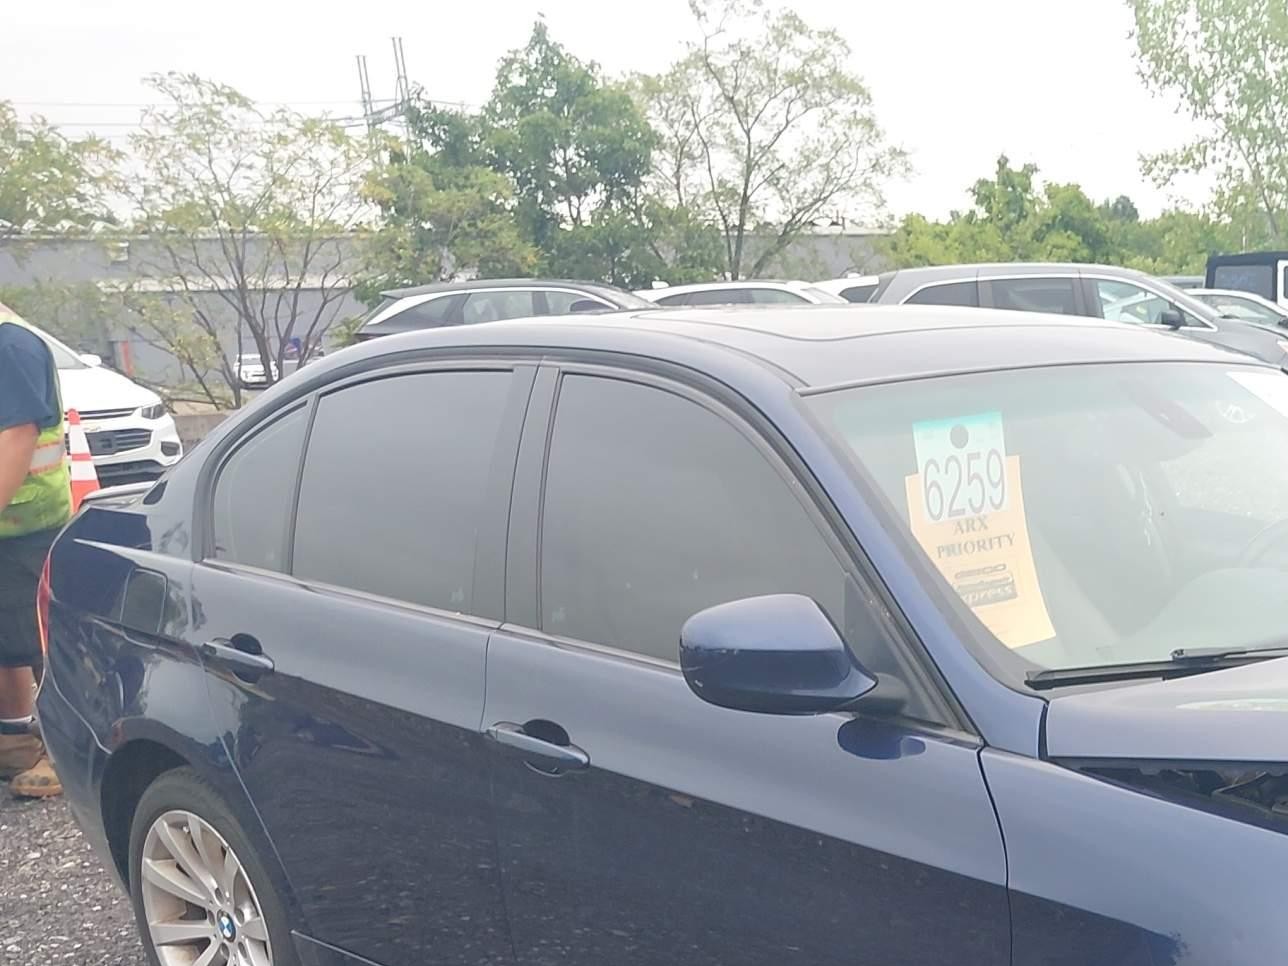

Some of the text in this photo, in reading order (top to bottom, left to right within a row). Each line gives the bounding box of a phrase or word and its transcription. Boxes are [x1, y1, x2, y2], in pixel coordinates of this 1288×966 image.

[924, 449, 1005, 521] 6259
[955, 516, 989, 535] ARX
[937, 533, 1016, 559] PRIORITY
